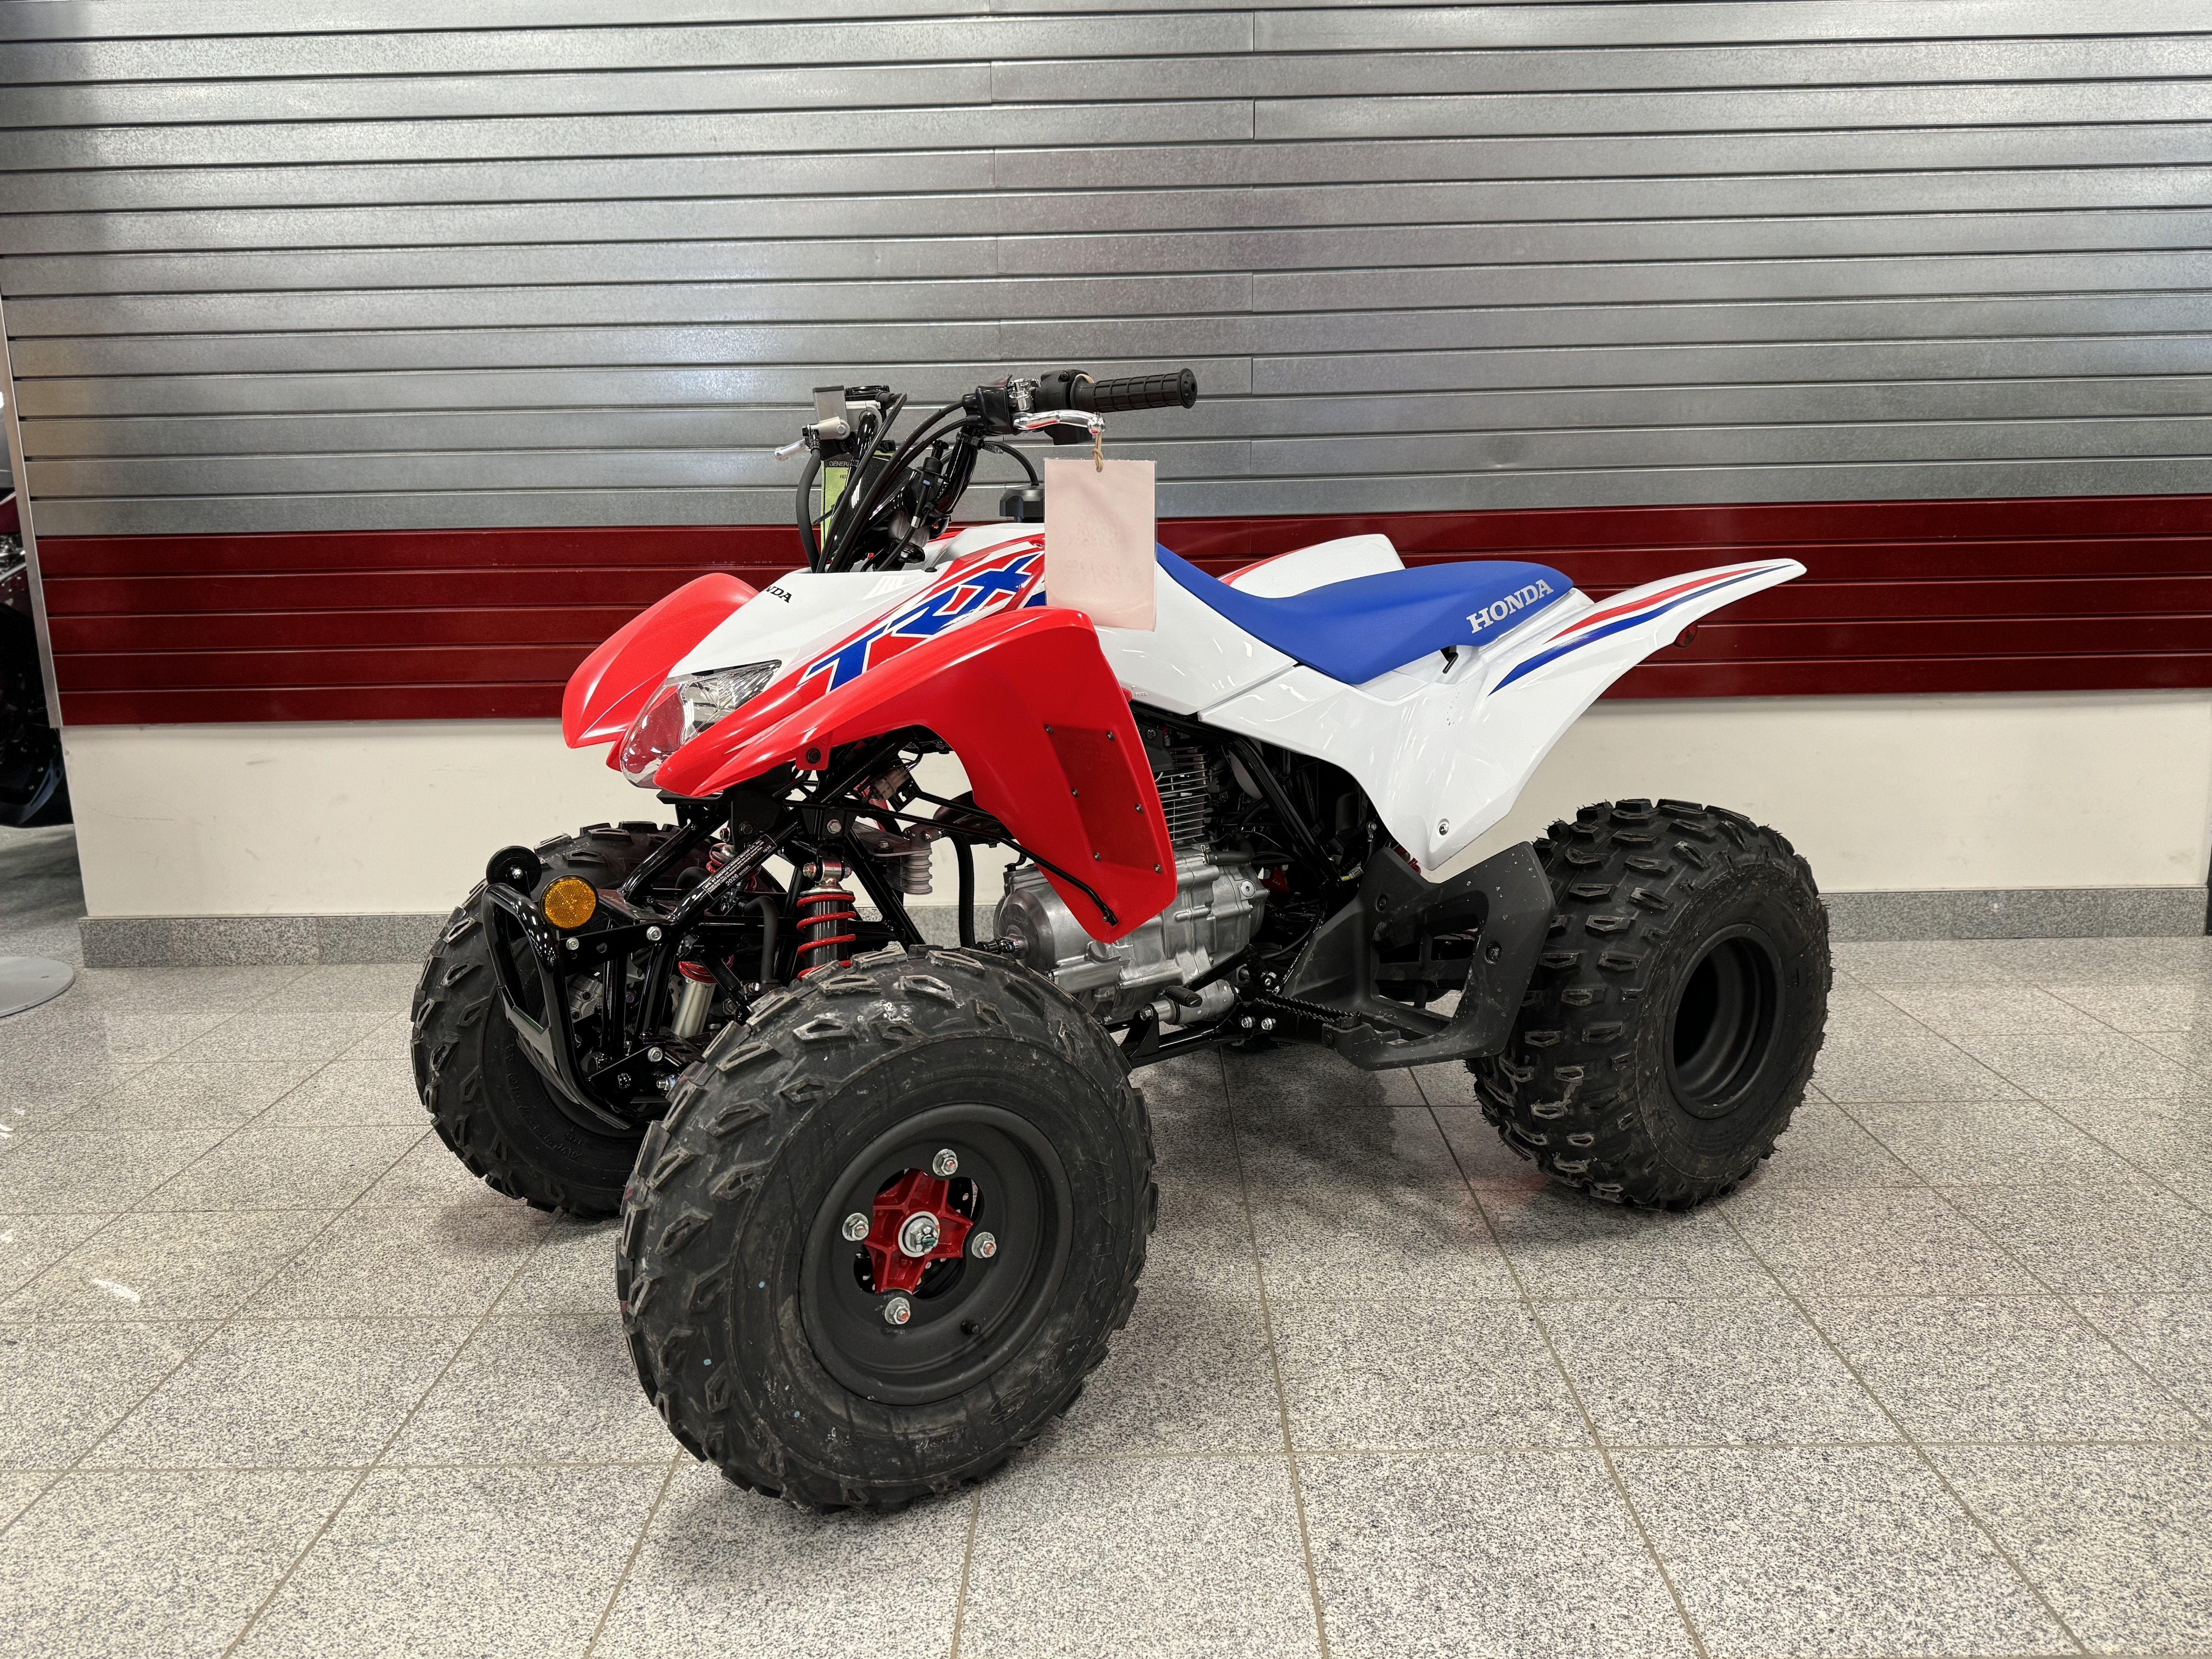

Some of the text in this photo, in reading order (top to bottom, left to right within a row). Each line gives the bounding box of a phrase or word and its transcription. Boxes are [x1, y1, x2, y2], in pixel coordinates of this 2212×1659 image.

[802, 551, 1043, 692] TRX
[1466, 579, 1554, 634] HONDA
[725, 874, 738, 886] 2026
[739, 865, 750, 875] MODEL
